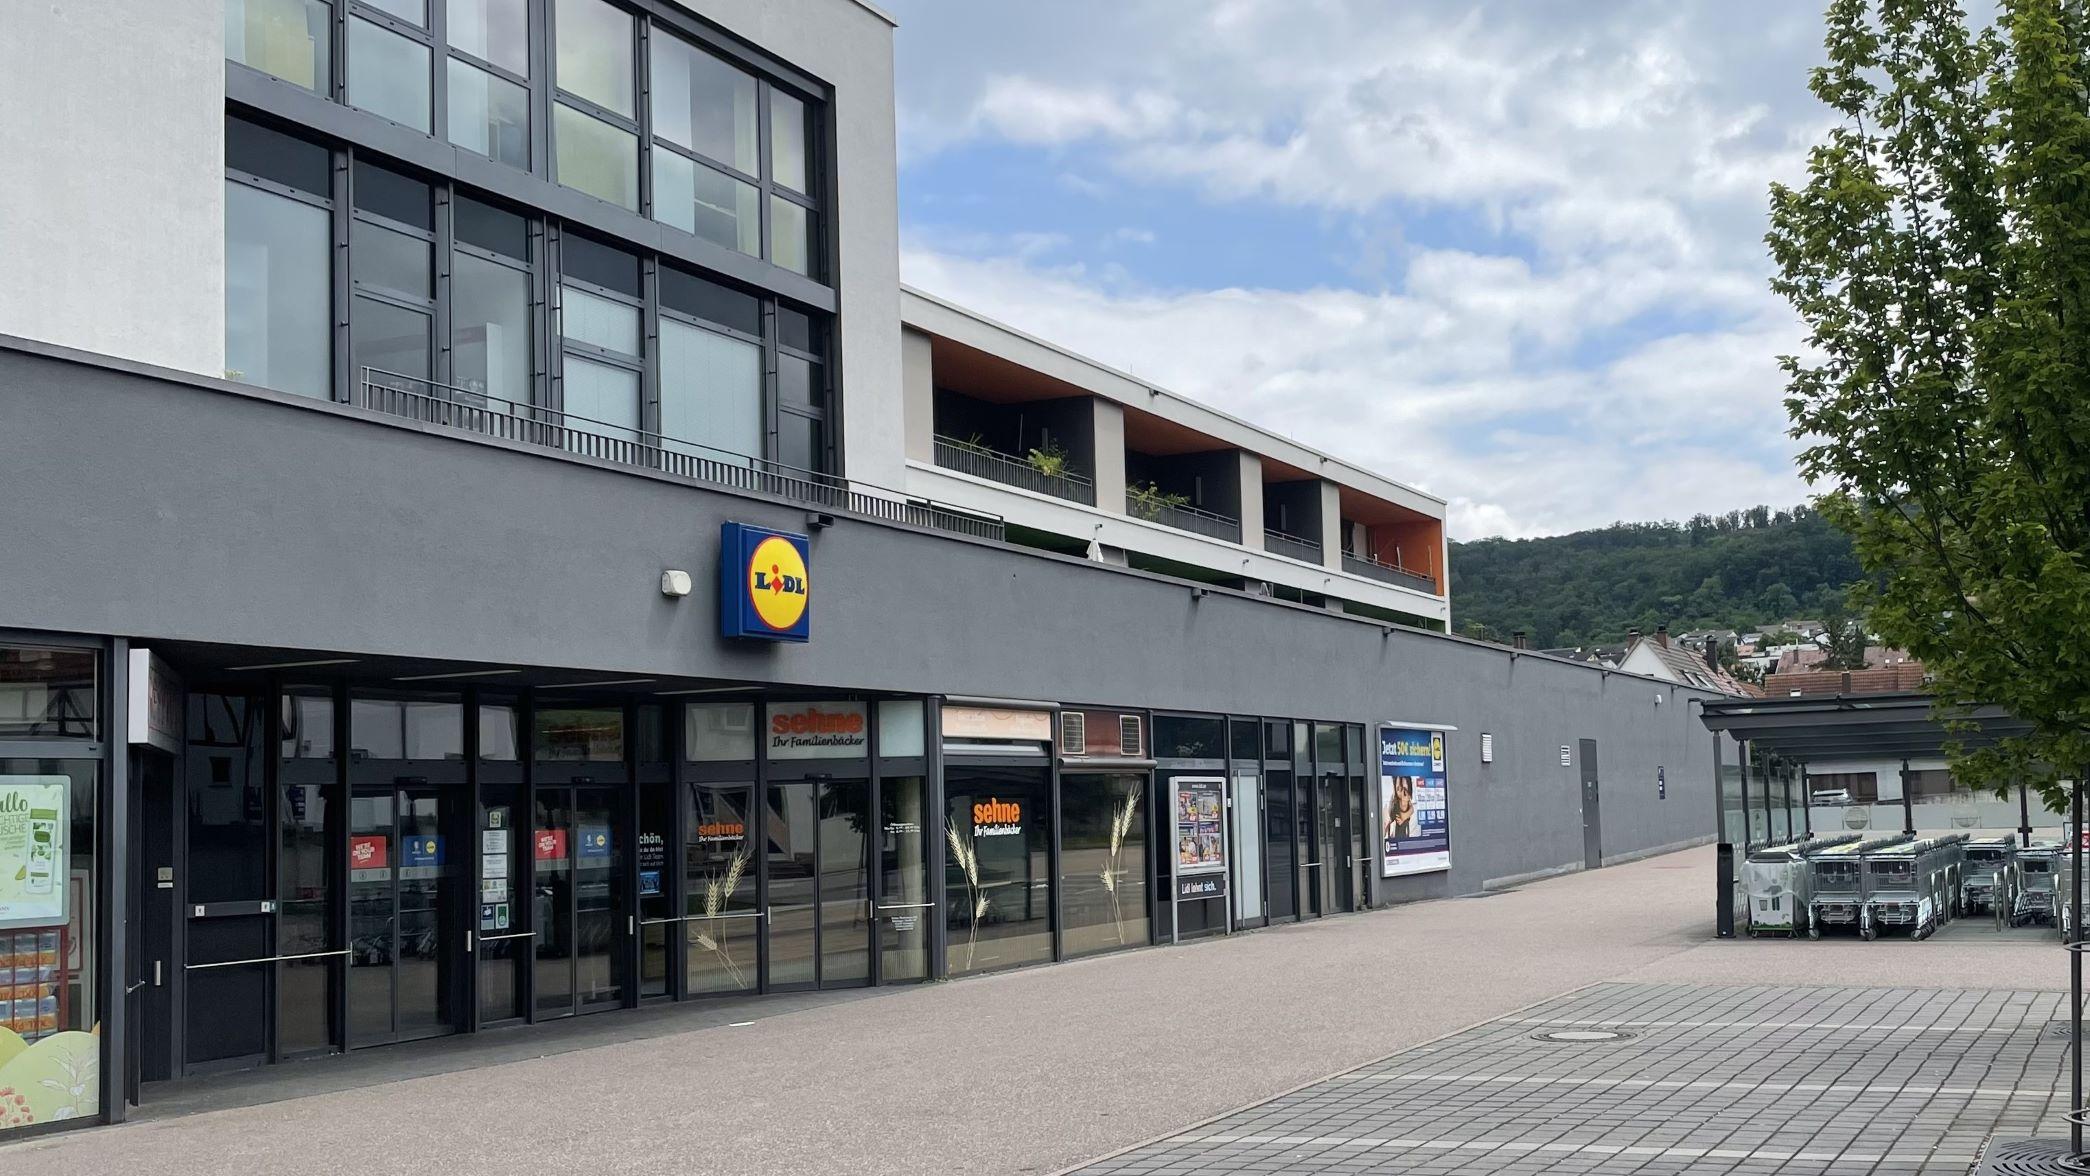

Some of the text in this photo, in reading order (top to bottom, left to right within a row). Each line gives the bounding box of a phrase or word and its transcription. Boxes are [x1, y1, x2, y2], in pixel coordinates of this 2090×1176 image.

[772, 708, 864, 735] sehne
[772, 735, 864, 748] Ihr Familienbäcker
[1382, 740, 1397, 755] Jetzt
[974, 797, 1020, 823] sehne
[698, 822, 744, 835] sehne
[974, 825, 983, 837] Ihr
[1182, 880, 1217, 894] Lidl lohnt sich.
